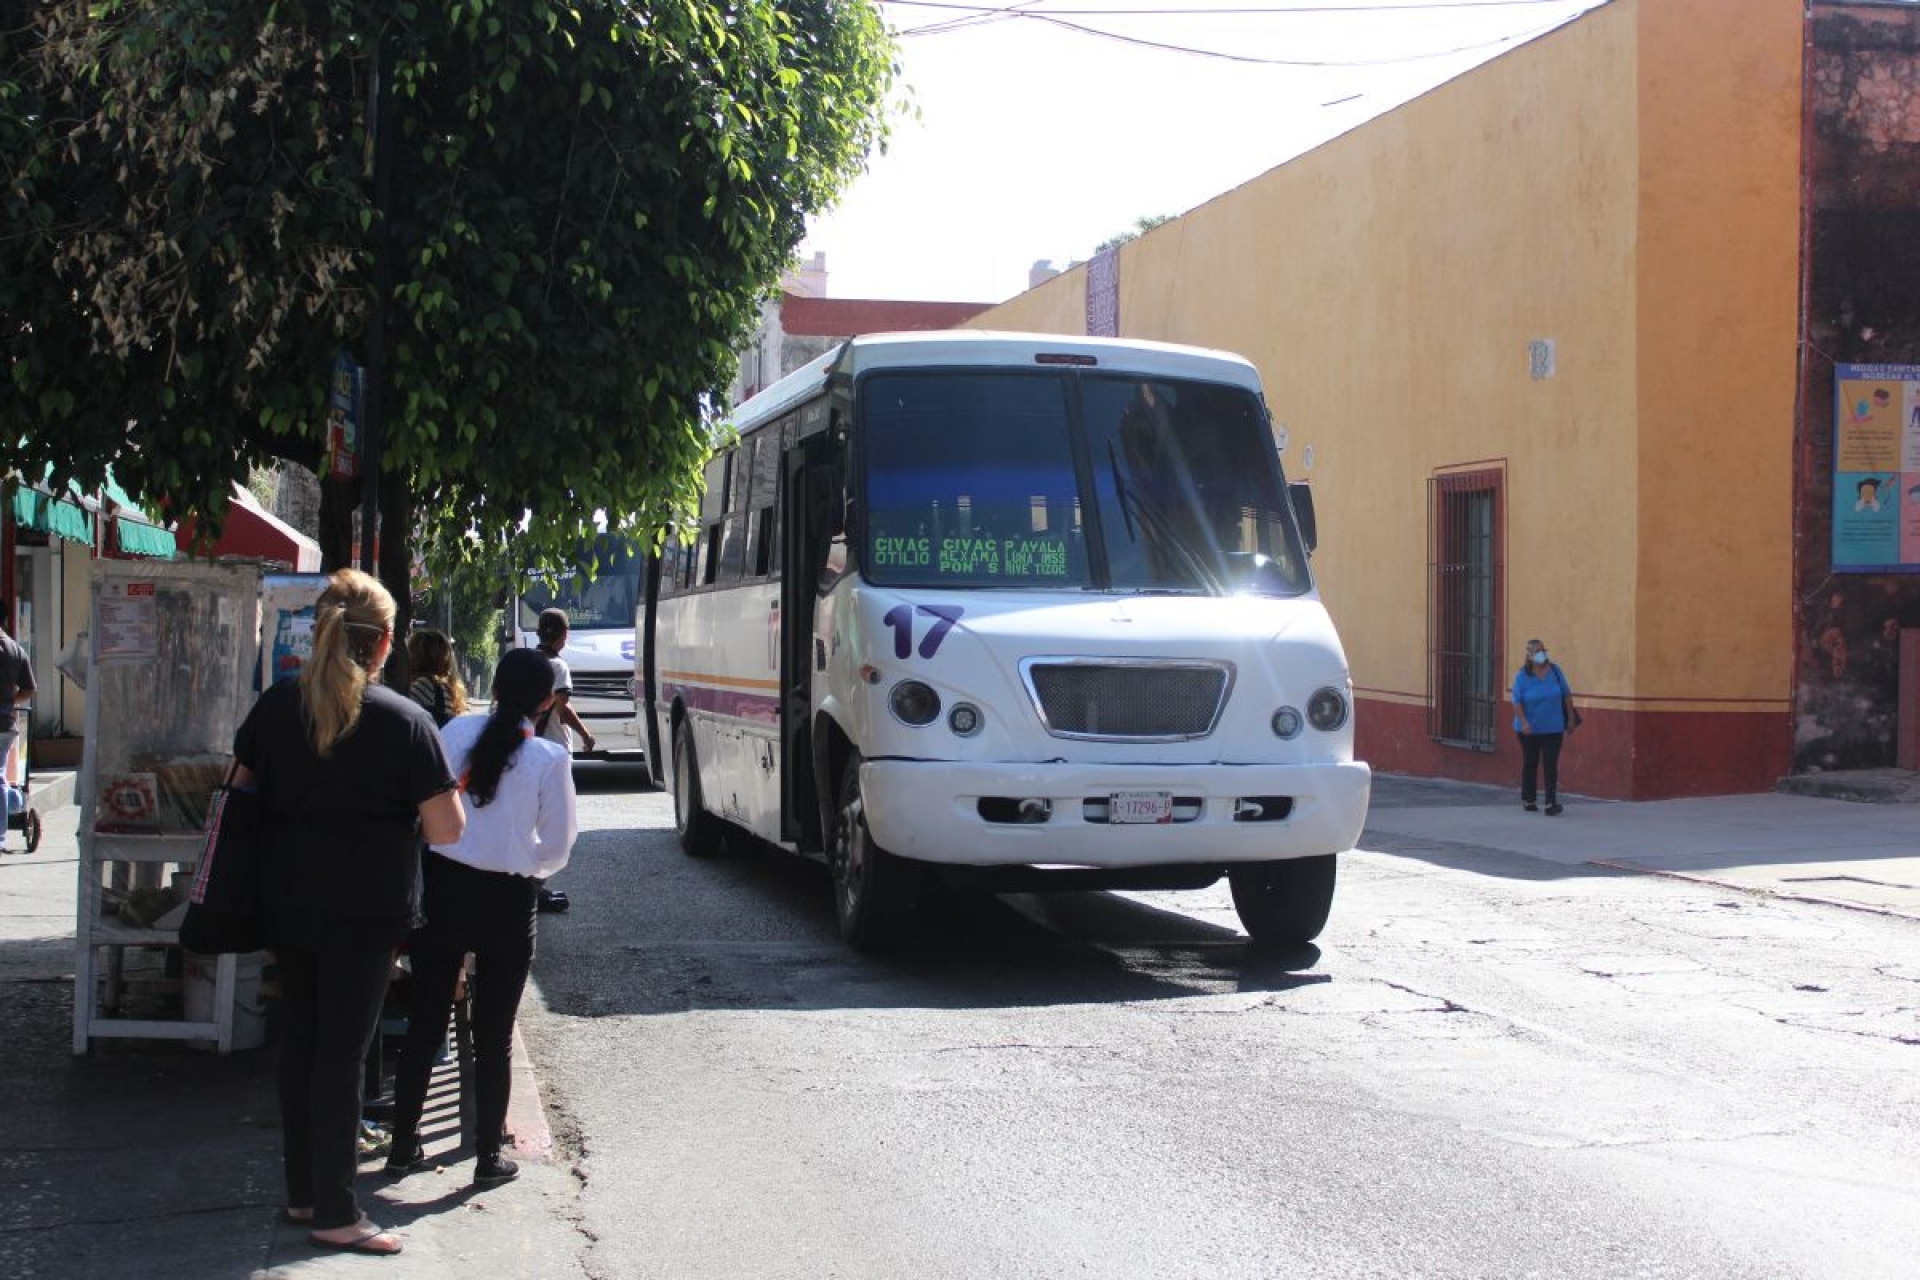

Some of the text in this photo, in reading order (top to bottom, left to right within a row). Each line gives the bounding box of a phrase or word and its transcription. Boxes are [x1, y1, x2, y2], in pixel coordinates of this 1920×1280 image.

[875, 538, 930, 551] CIVAC
[943, 538, 997, 551] CIVAC
[1021, 541, 1065, 552] AYALA
[875, 551, 930, 565] OTILIO
[883, 605, 965, 659] 17
